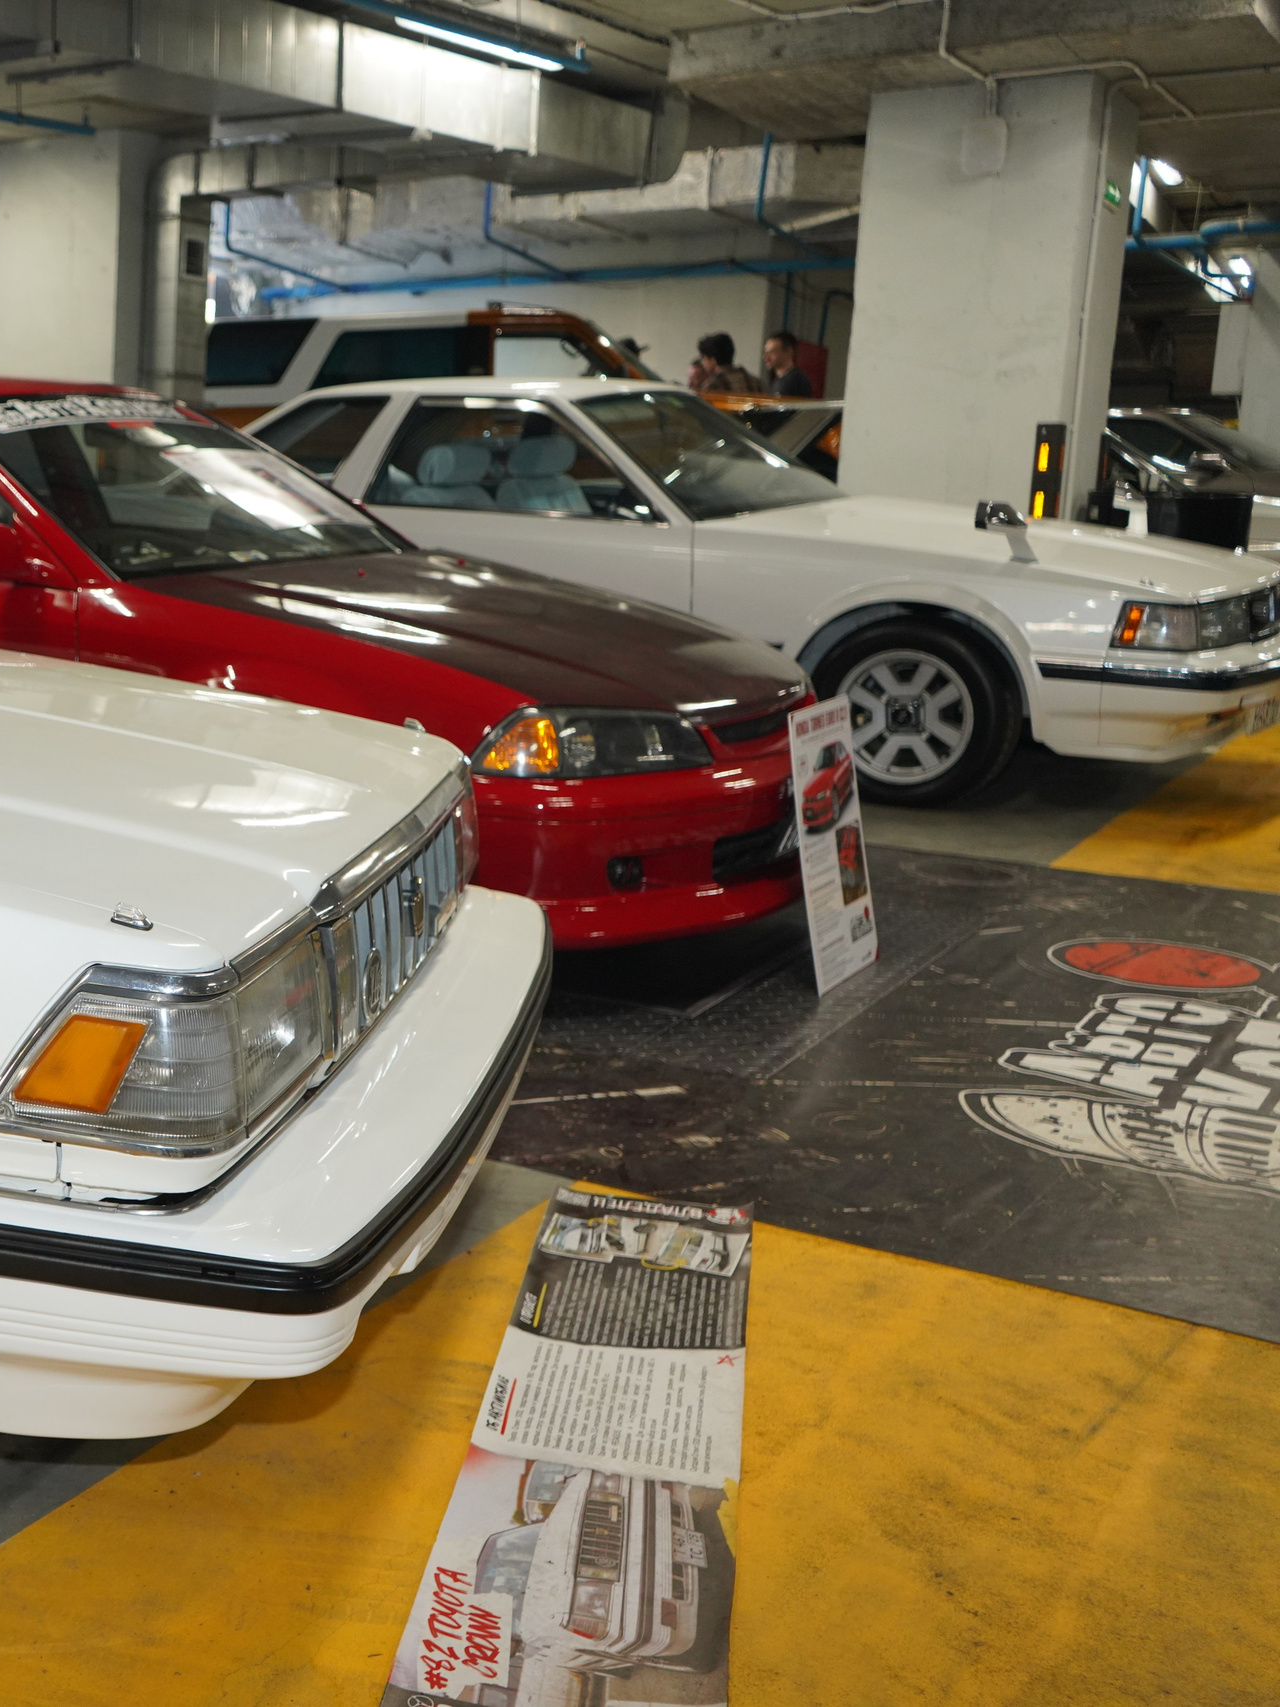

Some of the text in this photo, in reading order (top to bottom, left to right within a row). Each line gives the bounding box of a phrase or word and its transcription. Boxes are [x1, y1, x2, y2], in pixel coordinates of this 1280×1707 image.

[592, 1195, 704, 1220] ВЛАДЕЛЕЦ
[420, 1566, 473, 1690] #82 TOYOTA
[461, 1604, 503, 1679] CROWN
